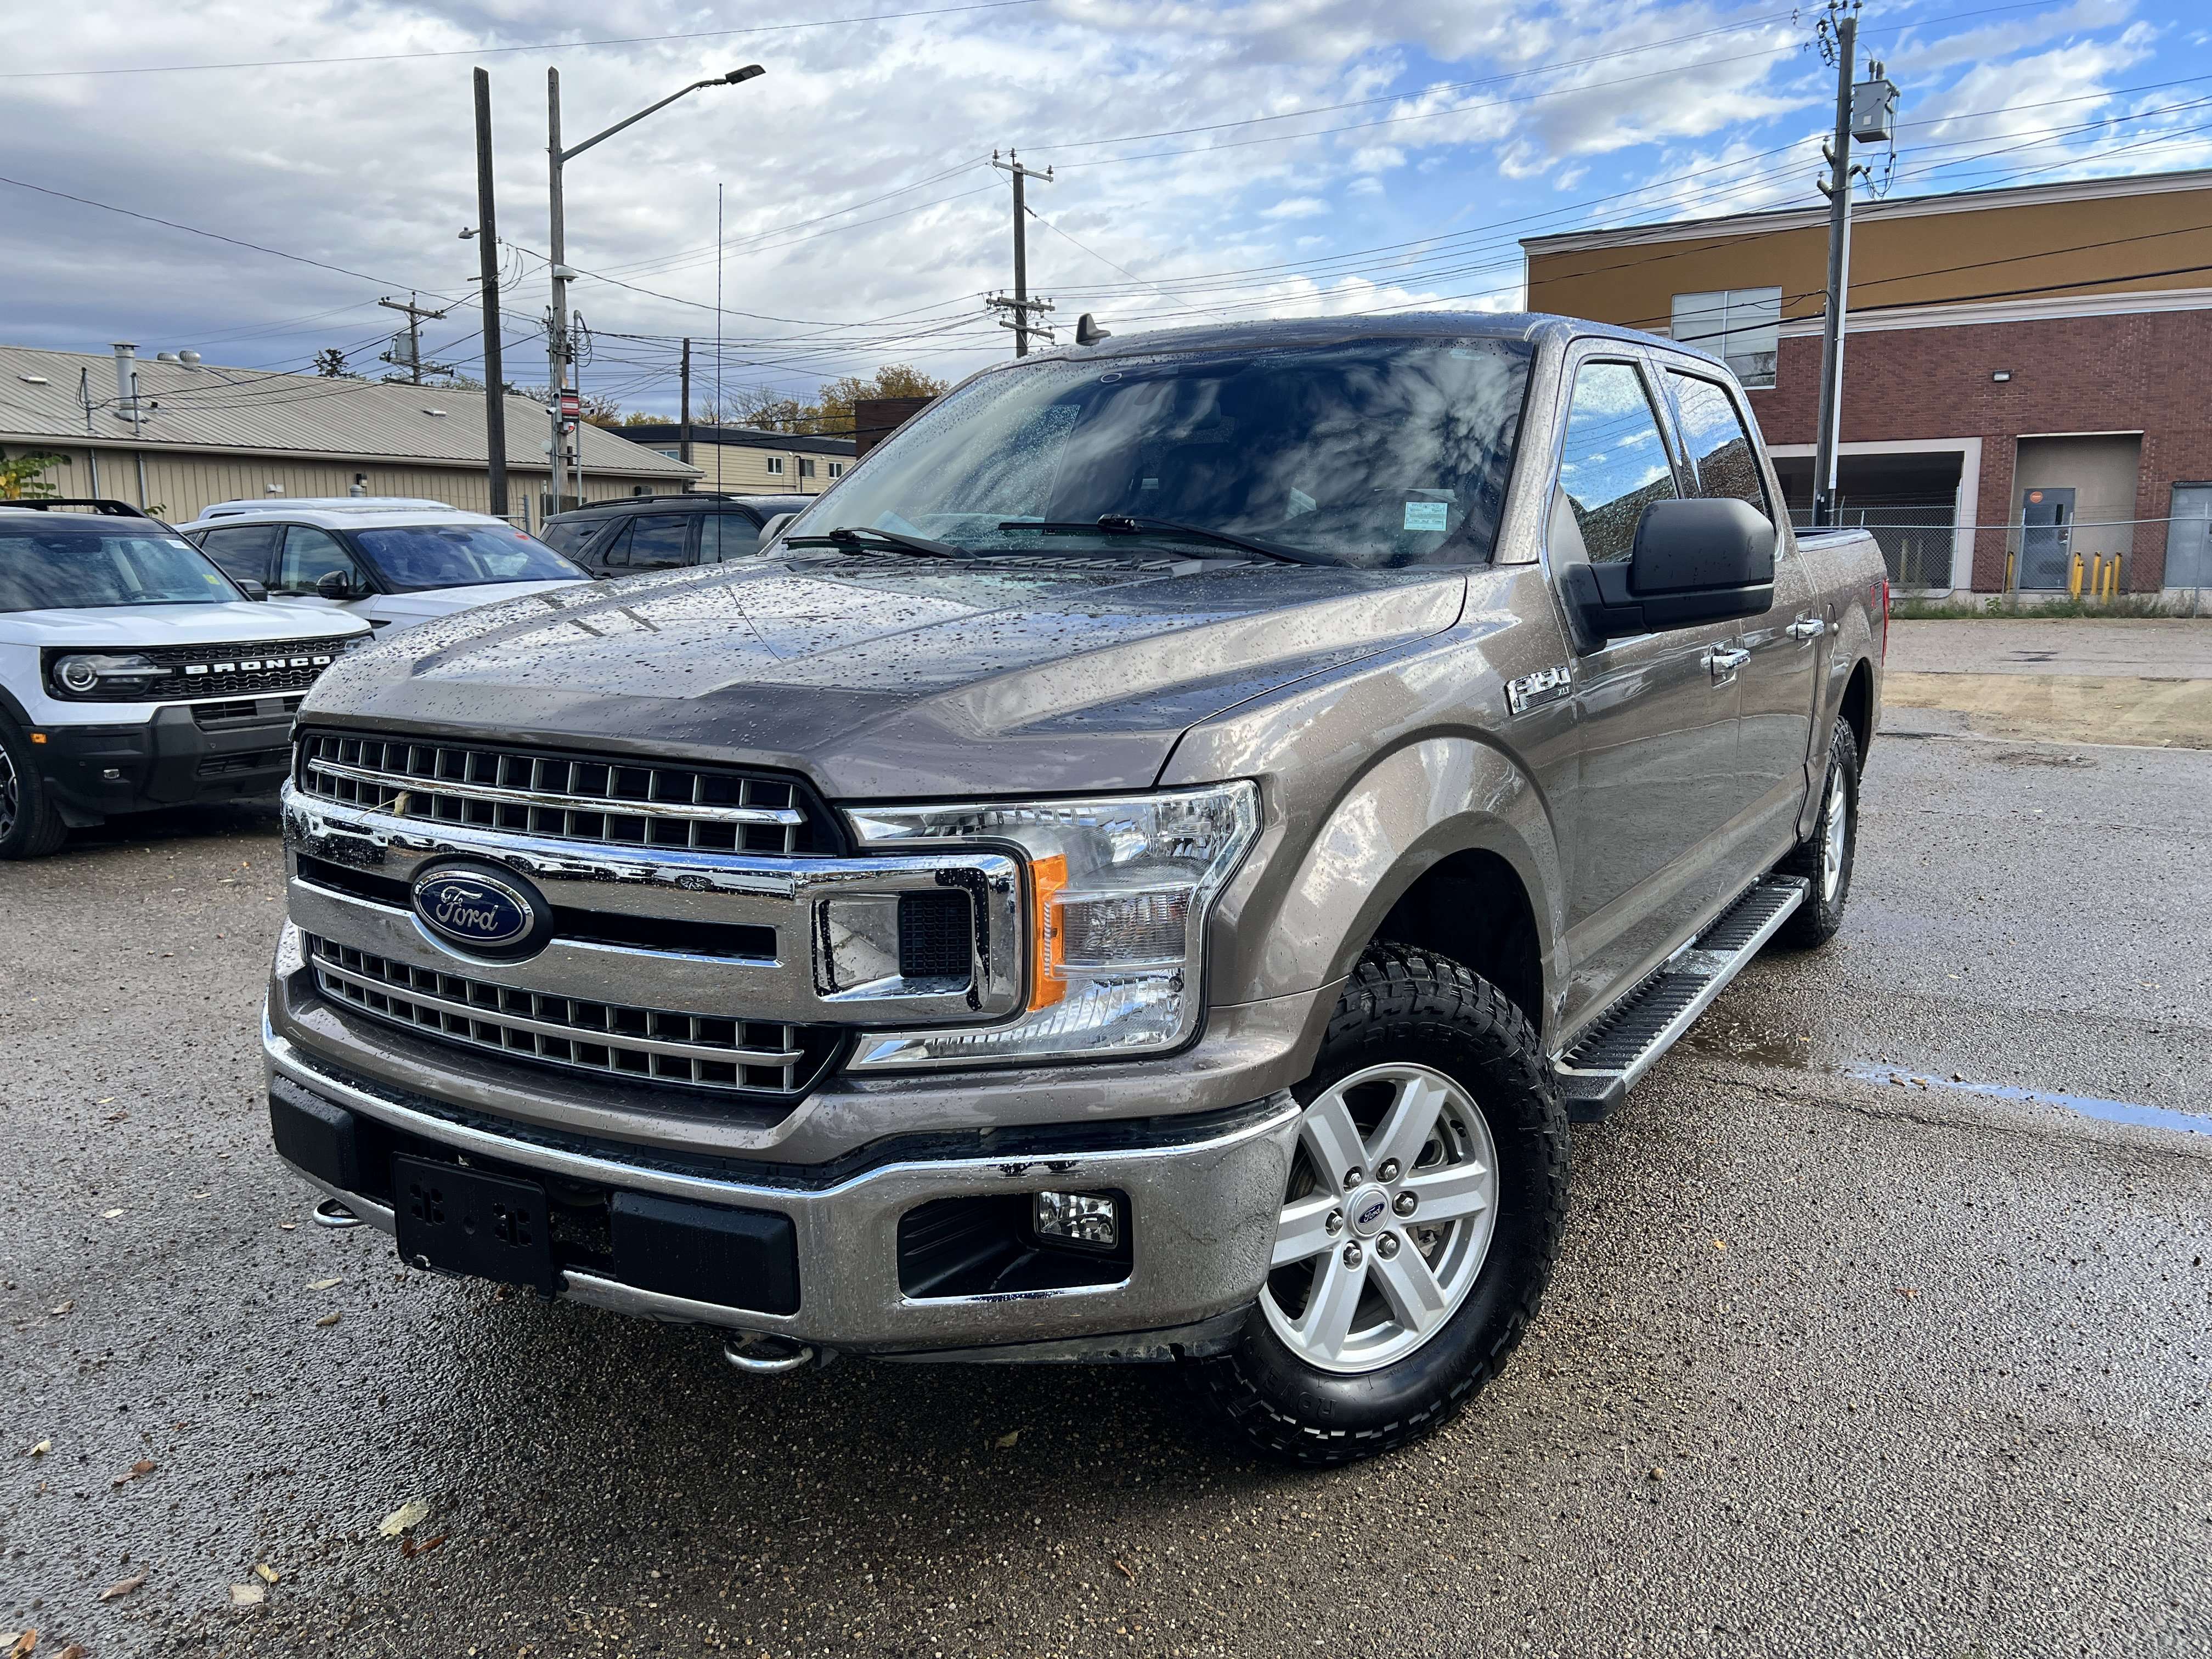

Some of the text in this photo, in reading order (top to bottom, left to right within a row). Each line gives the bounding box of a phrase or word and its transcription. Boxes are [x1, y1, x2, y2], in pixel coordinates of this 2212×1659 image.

[185, 655, 330, 675] BRONCO
[1557, 686, 1570, 697] XLT
[436, 885, 499, 932] Ford
[1363, 1205, 1382, 1223] Ford
